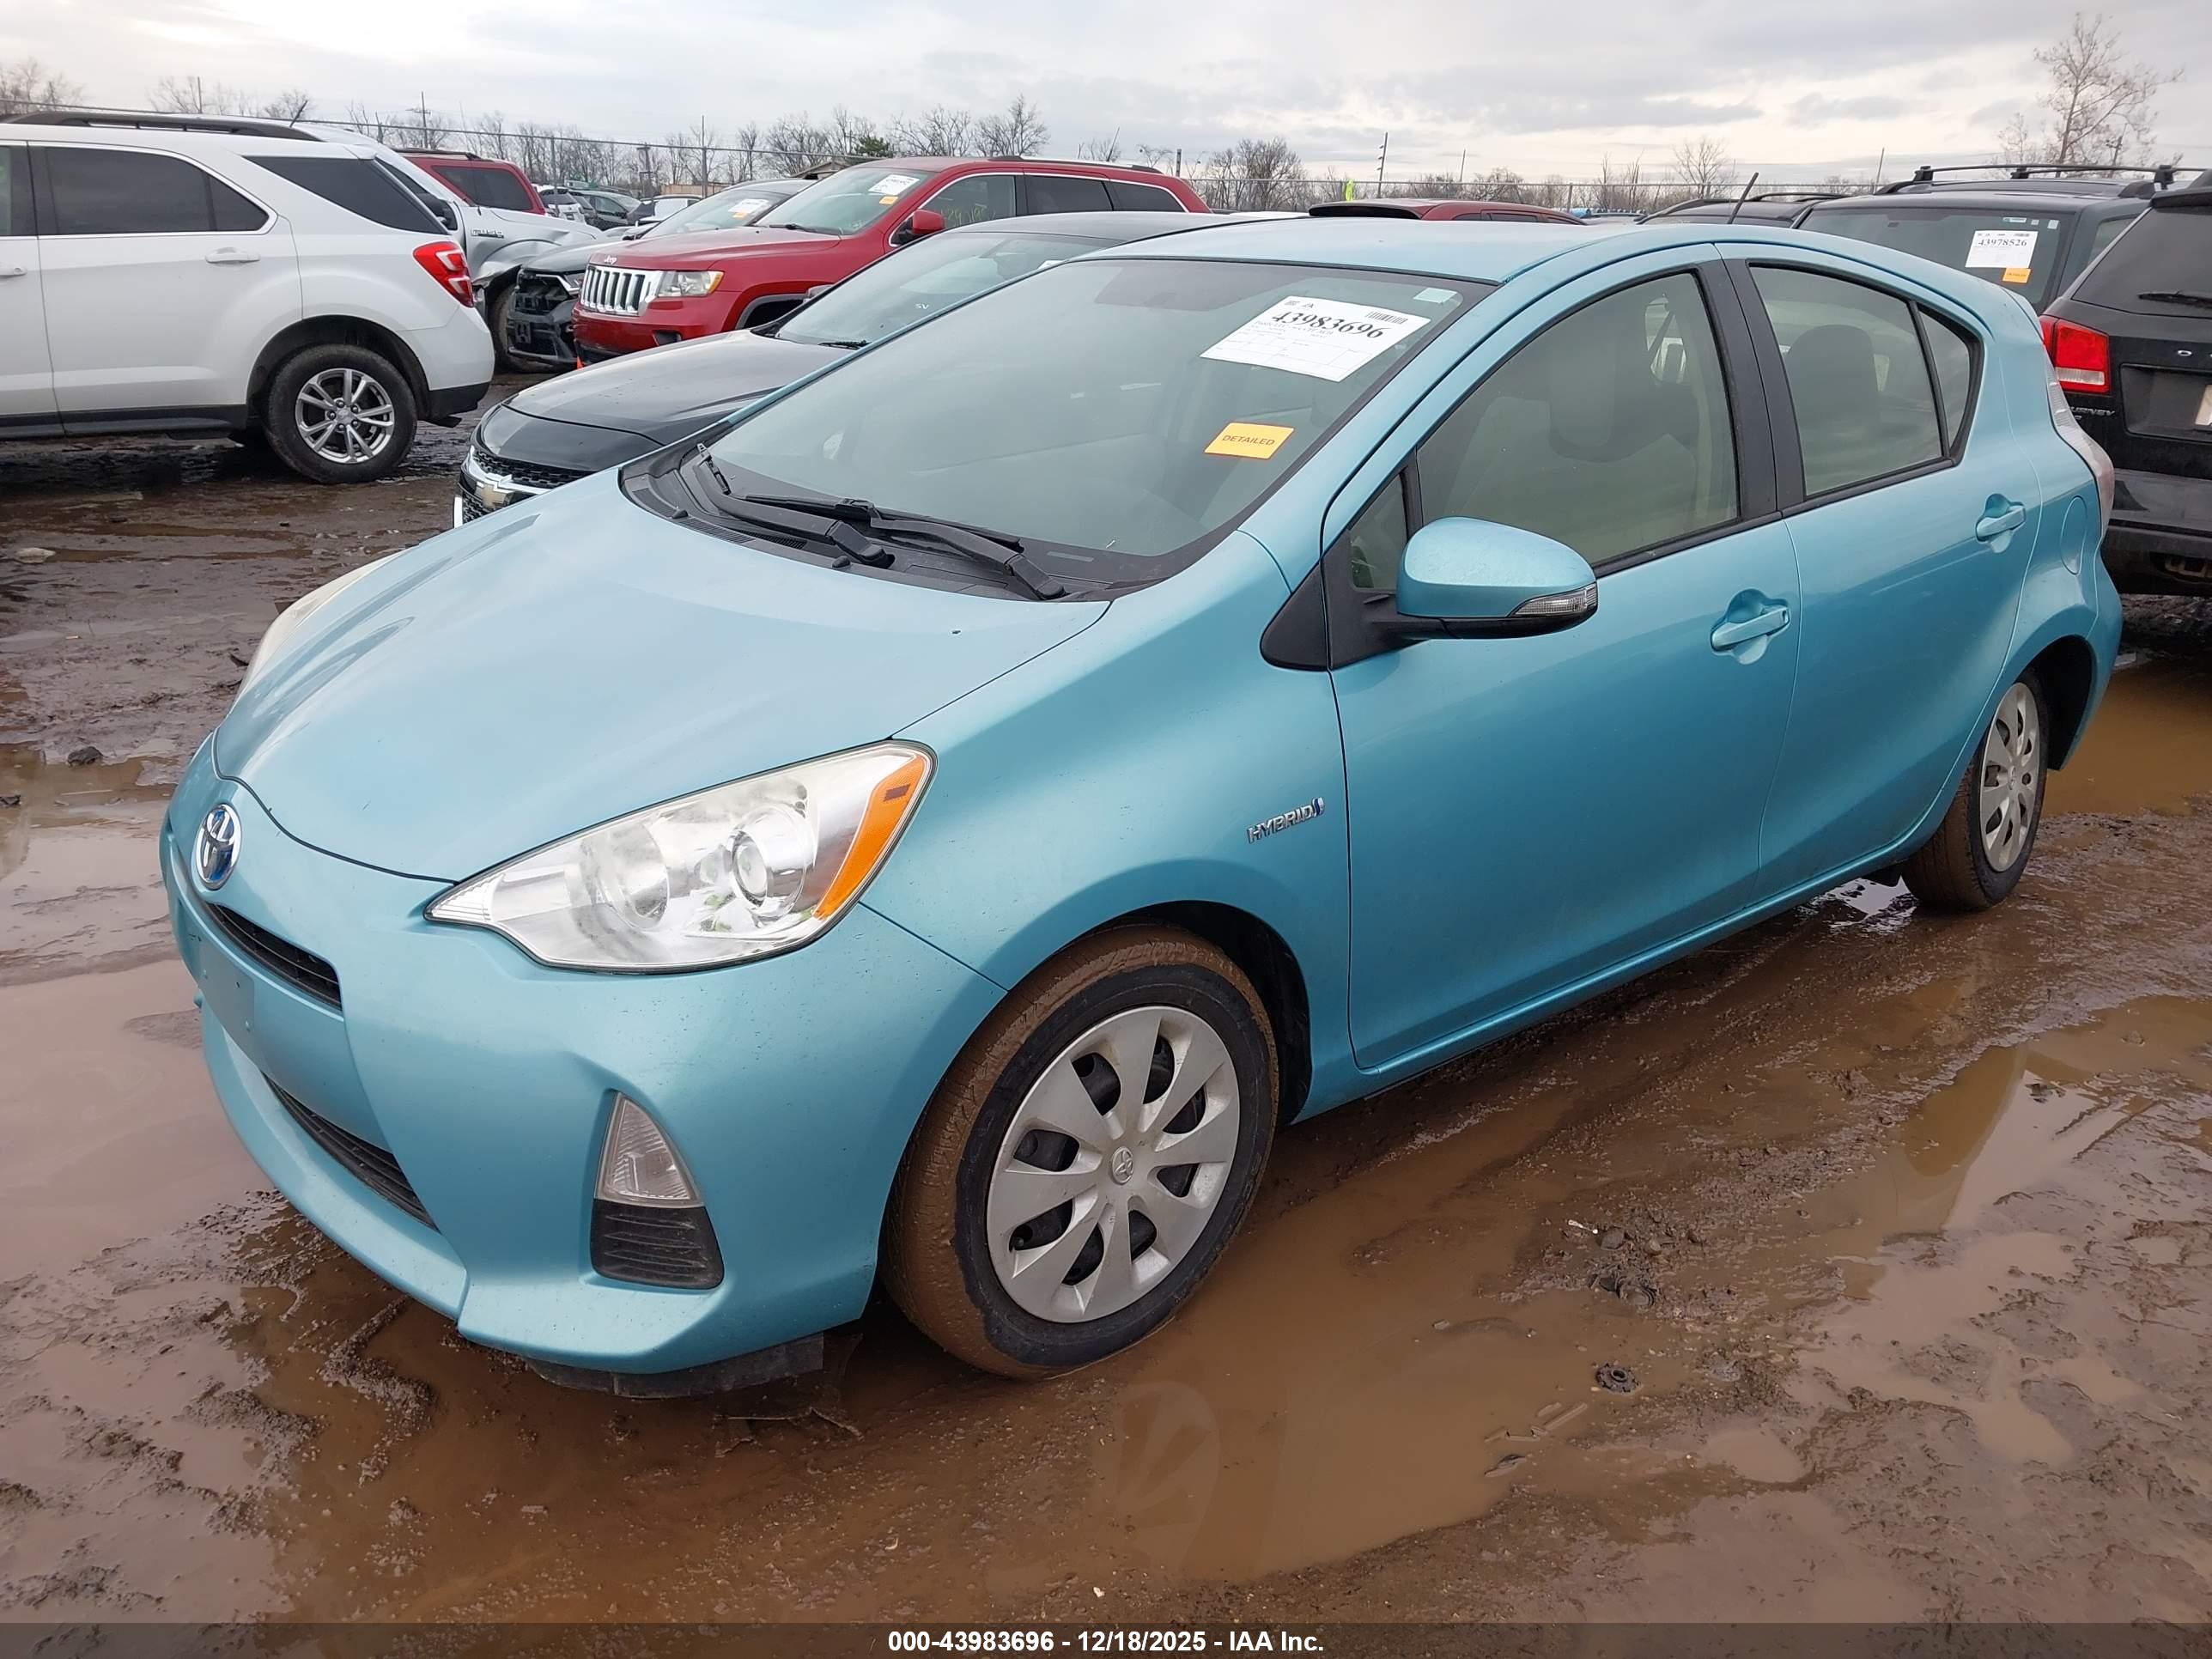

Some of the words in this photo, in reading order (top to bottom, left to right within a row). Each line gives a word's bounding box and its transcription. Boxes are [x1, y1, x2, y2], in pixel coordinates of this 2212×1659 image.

[1271, 311, 1392, 338] 43983696
[1222, 434, 1276, 446] DETAILED
[1247, 805, 1314, 844] HYBRID
